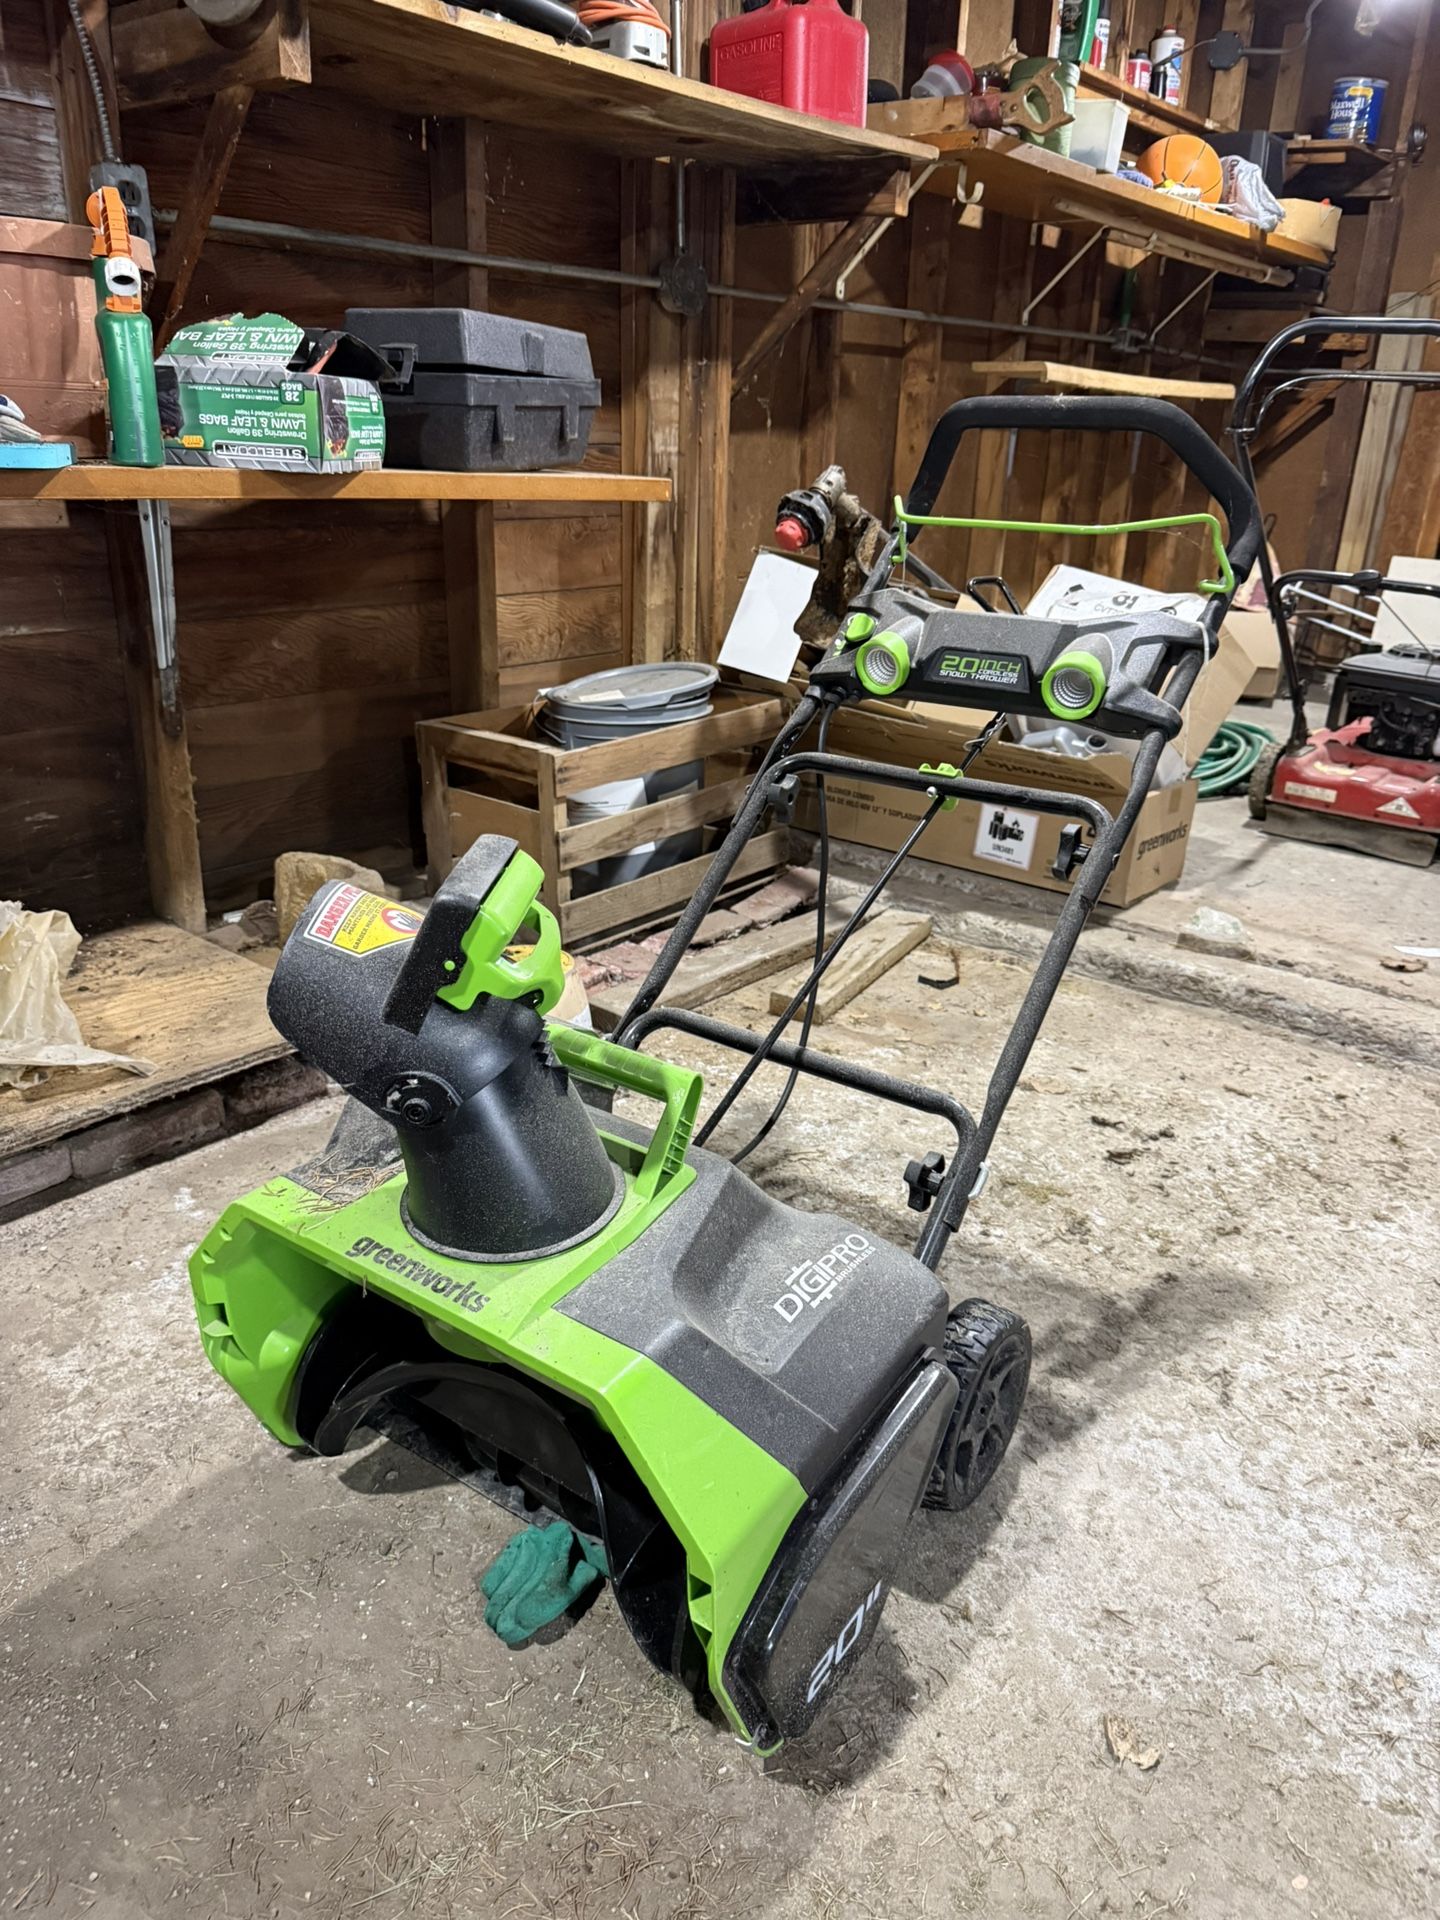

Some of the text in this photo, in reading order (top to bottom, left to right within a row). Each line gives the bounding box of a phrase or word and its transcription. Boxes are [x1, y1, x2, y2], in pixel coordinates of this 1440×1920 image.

[720, 33, 782, 60] GASOLINE
[1330, 97, 1365, 110] Maxwell
[203, 331, 247, 342] LEAF
[249, 332, 263, 342] &
[264, 332, 304, 344] WN
[192, 341, 228, 350] Gallon
[229, 342, 247, 350] 39
[281, 383, 303, 391] BAGS
[284, 391, 300, 402] 28
[198, 413, 306, 430] LAWN & LEAF BAGS
[227, 427, 307, 440] Drawstring 39 Gallon
[216, 444, 302, 459] STEELCOAT
[941, 655, 1022, 673] 20 INCH
[939, 670, 1018, 684] SNOW THROWER
[978, 668, 1018, 678] CORDLESS
[1137, 821, 1188, 861] greenworks
[834, 1245, 877, 1283] BRUSHLESS
[345, 1236, 491, 1314] greenworks
[773, 1233, 870, 1324] DIGIPRO
